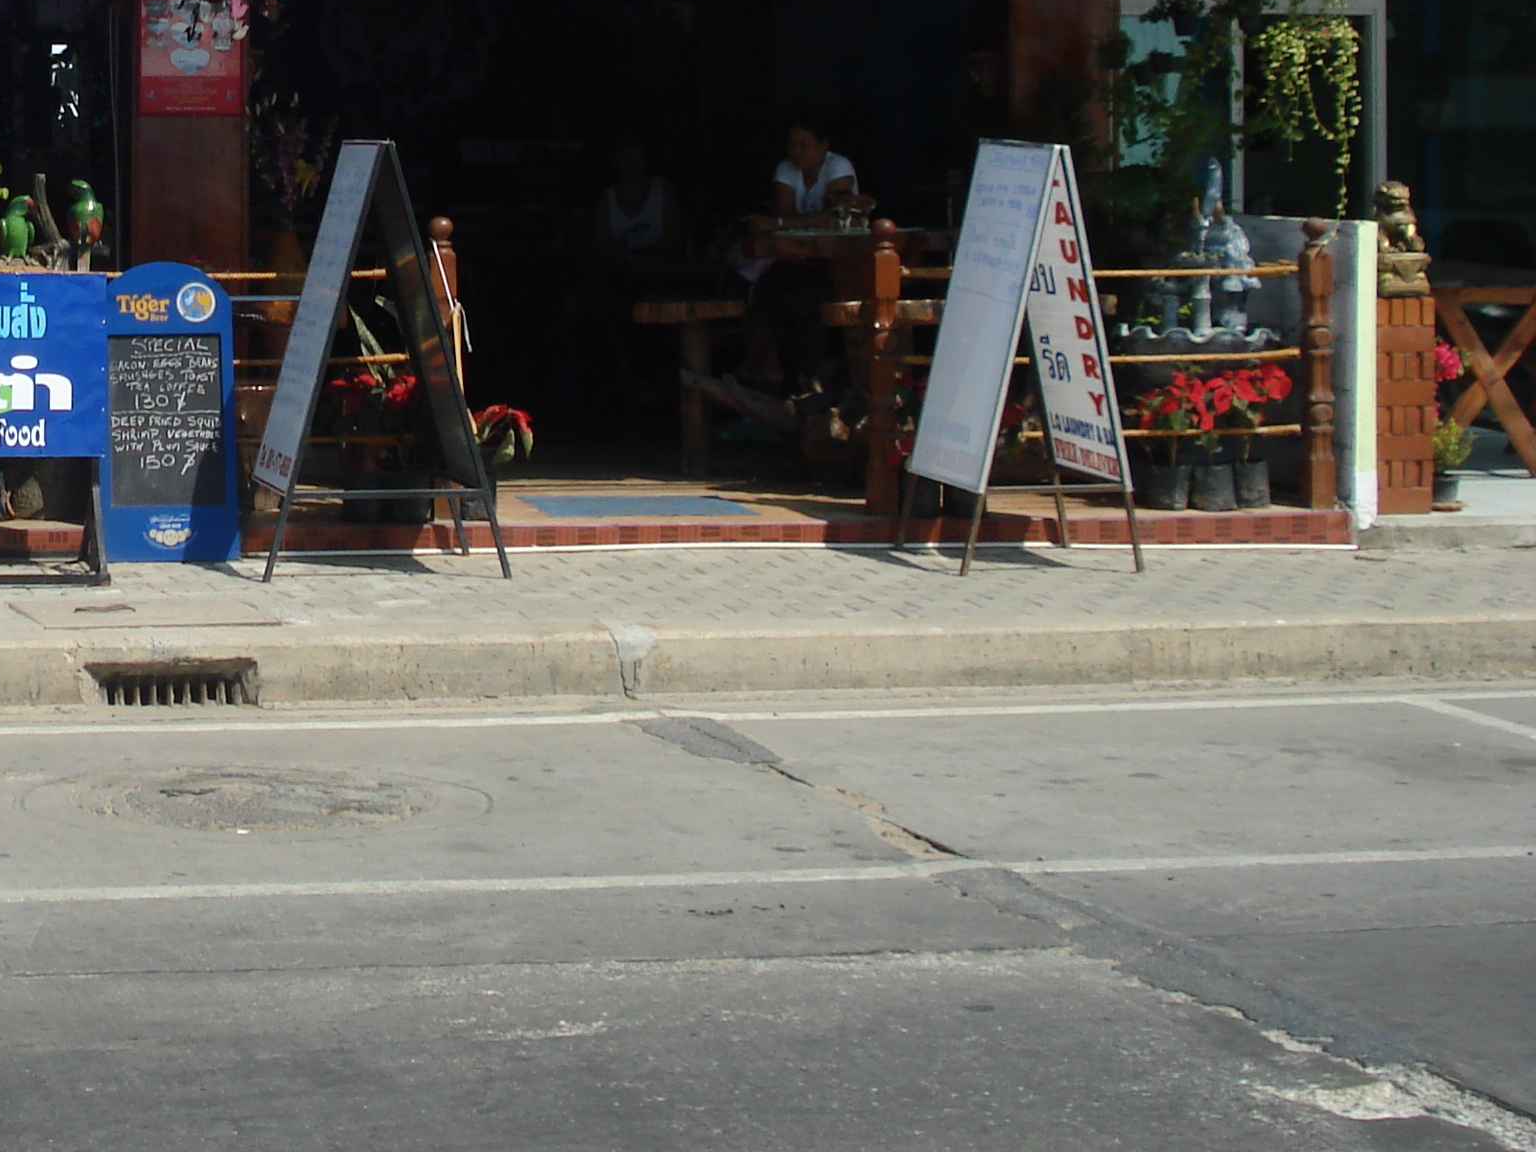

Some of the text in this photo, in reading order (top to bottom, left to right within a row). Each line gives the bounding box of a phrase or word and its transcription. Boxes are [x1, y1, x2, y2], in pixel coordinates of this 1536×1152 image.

[1052, 178, 1105, 416] AUNDRY
[116, 292, 171, 322] Tiger
[131, 337, 210, 354] SPECIAL
[185, 355, 219, 369] BEANS
[180, 369, 216, 383] TOAST
[126, 382, 151, 392] TEA
[134, 394, 169, 411] 130
[111, 415, 145, 428] DEEP
[149, 414, 182, 427] FRIED
[114, 441, 145, 453] WITH
[152, 439, 181, 453] PLUM
[140, 453, 176, 470] 150
